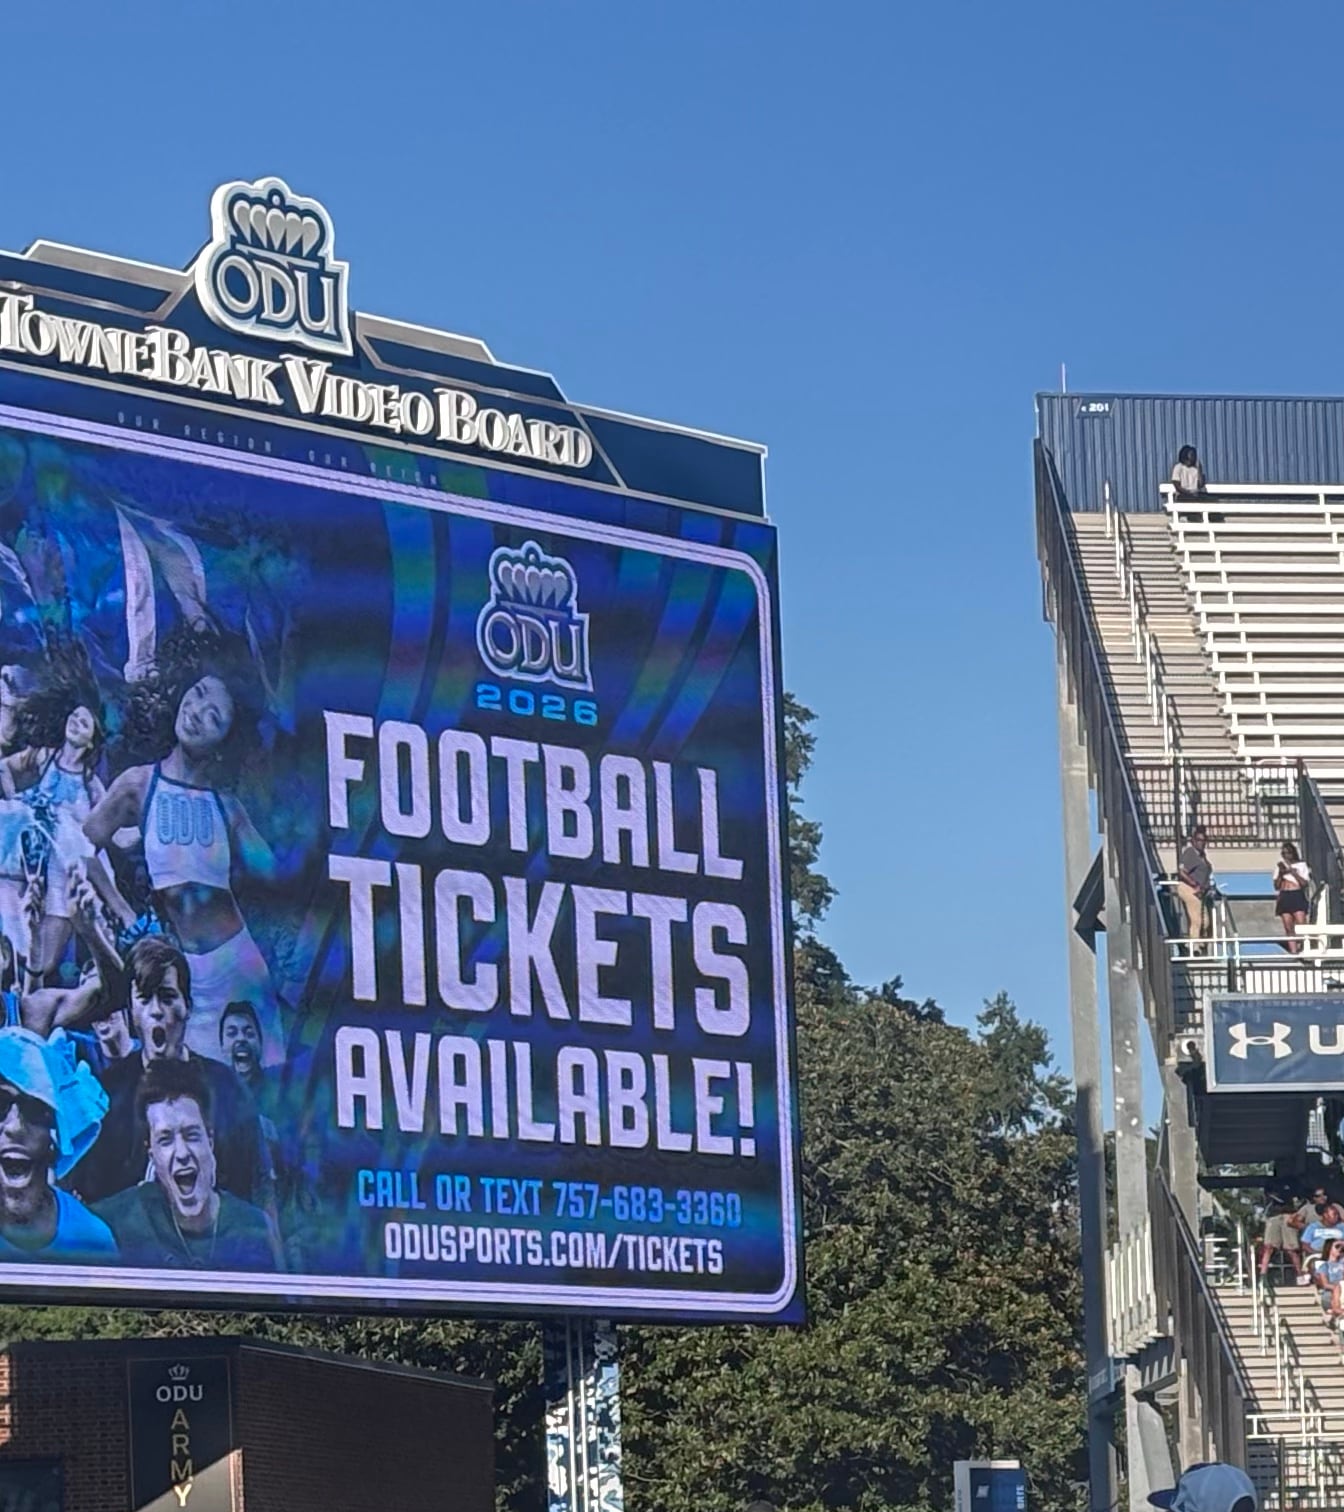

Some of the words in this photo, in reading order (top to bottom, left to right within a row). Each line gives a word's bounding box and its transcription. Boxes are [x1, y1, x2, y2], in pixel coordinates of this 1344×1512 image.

[216, 254, 336, 333] ODU
[484, 610, 582, 678] ODU
[477, 683, 599, 726] 2026
[324, 709, 744, 880] FOOTBALL
[329, 856, 750, 1037] TICKETS
[335, 1026, 756, 1157] AVAILABLE!
[358, 1169, 426, 1209] CALL
[437, 1175, 470, 1212] OR
[480, 1178, 543, 1216] TEXT
[553, 1182, 742, 1227] 757-683-3360
[385, 1222, 723, 1275] ODUSPORTS.COM/TICKETS
[156, 1384, 203, 1402] ODU
[171, 1408, 193, 1507] ARMY
